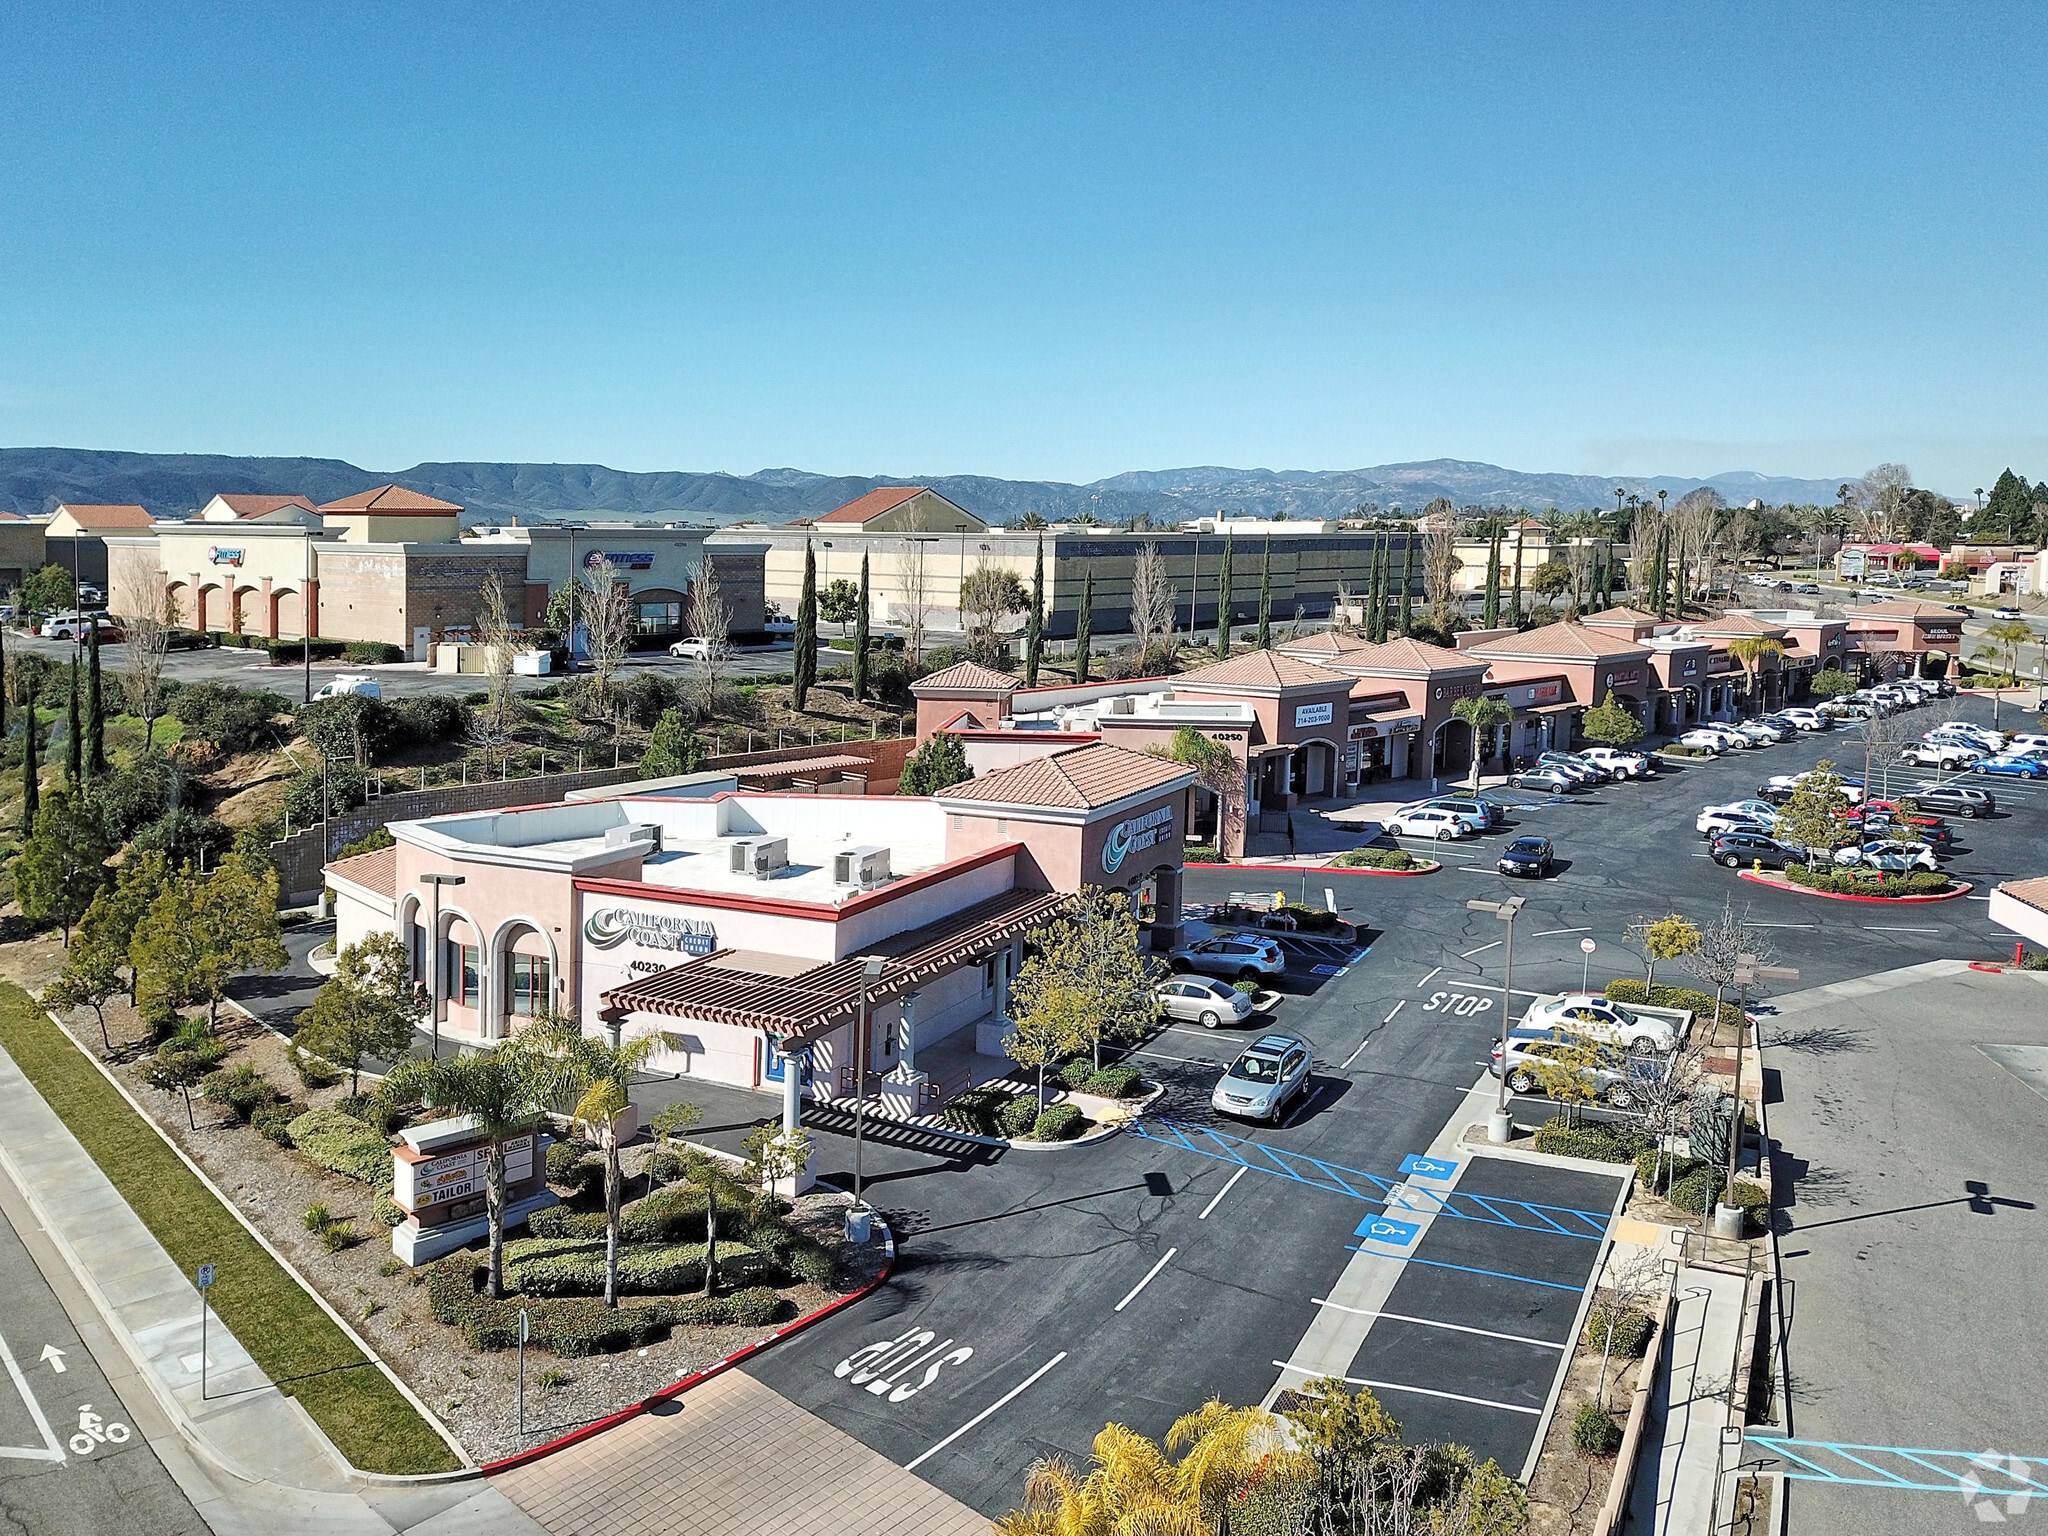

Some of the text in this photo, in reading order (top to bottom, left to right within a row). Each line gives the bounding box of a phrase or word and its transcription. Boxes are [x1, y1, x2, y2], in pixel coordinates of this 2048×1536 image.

[1301, 705, 1328, 715] AVAILABLE
[1211, 733, 1243, 742] 40250
[1128, 828, 1158, 854] COAST
[614, 908, 717, 936] CALIFORNIA
[627, 926, 683, 948] COAST
[630, 960, 667, 973] 40230
[1422, 991, 1494, 1017] STOP
[431, 1153, 467, 1167] CALIFORNIA
[436, 1161, 456, 1171] COAST
[432, 1182, 472, 1202] TAILOR
[834, 1326, 974, 1403] STOP
